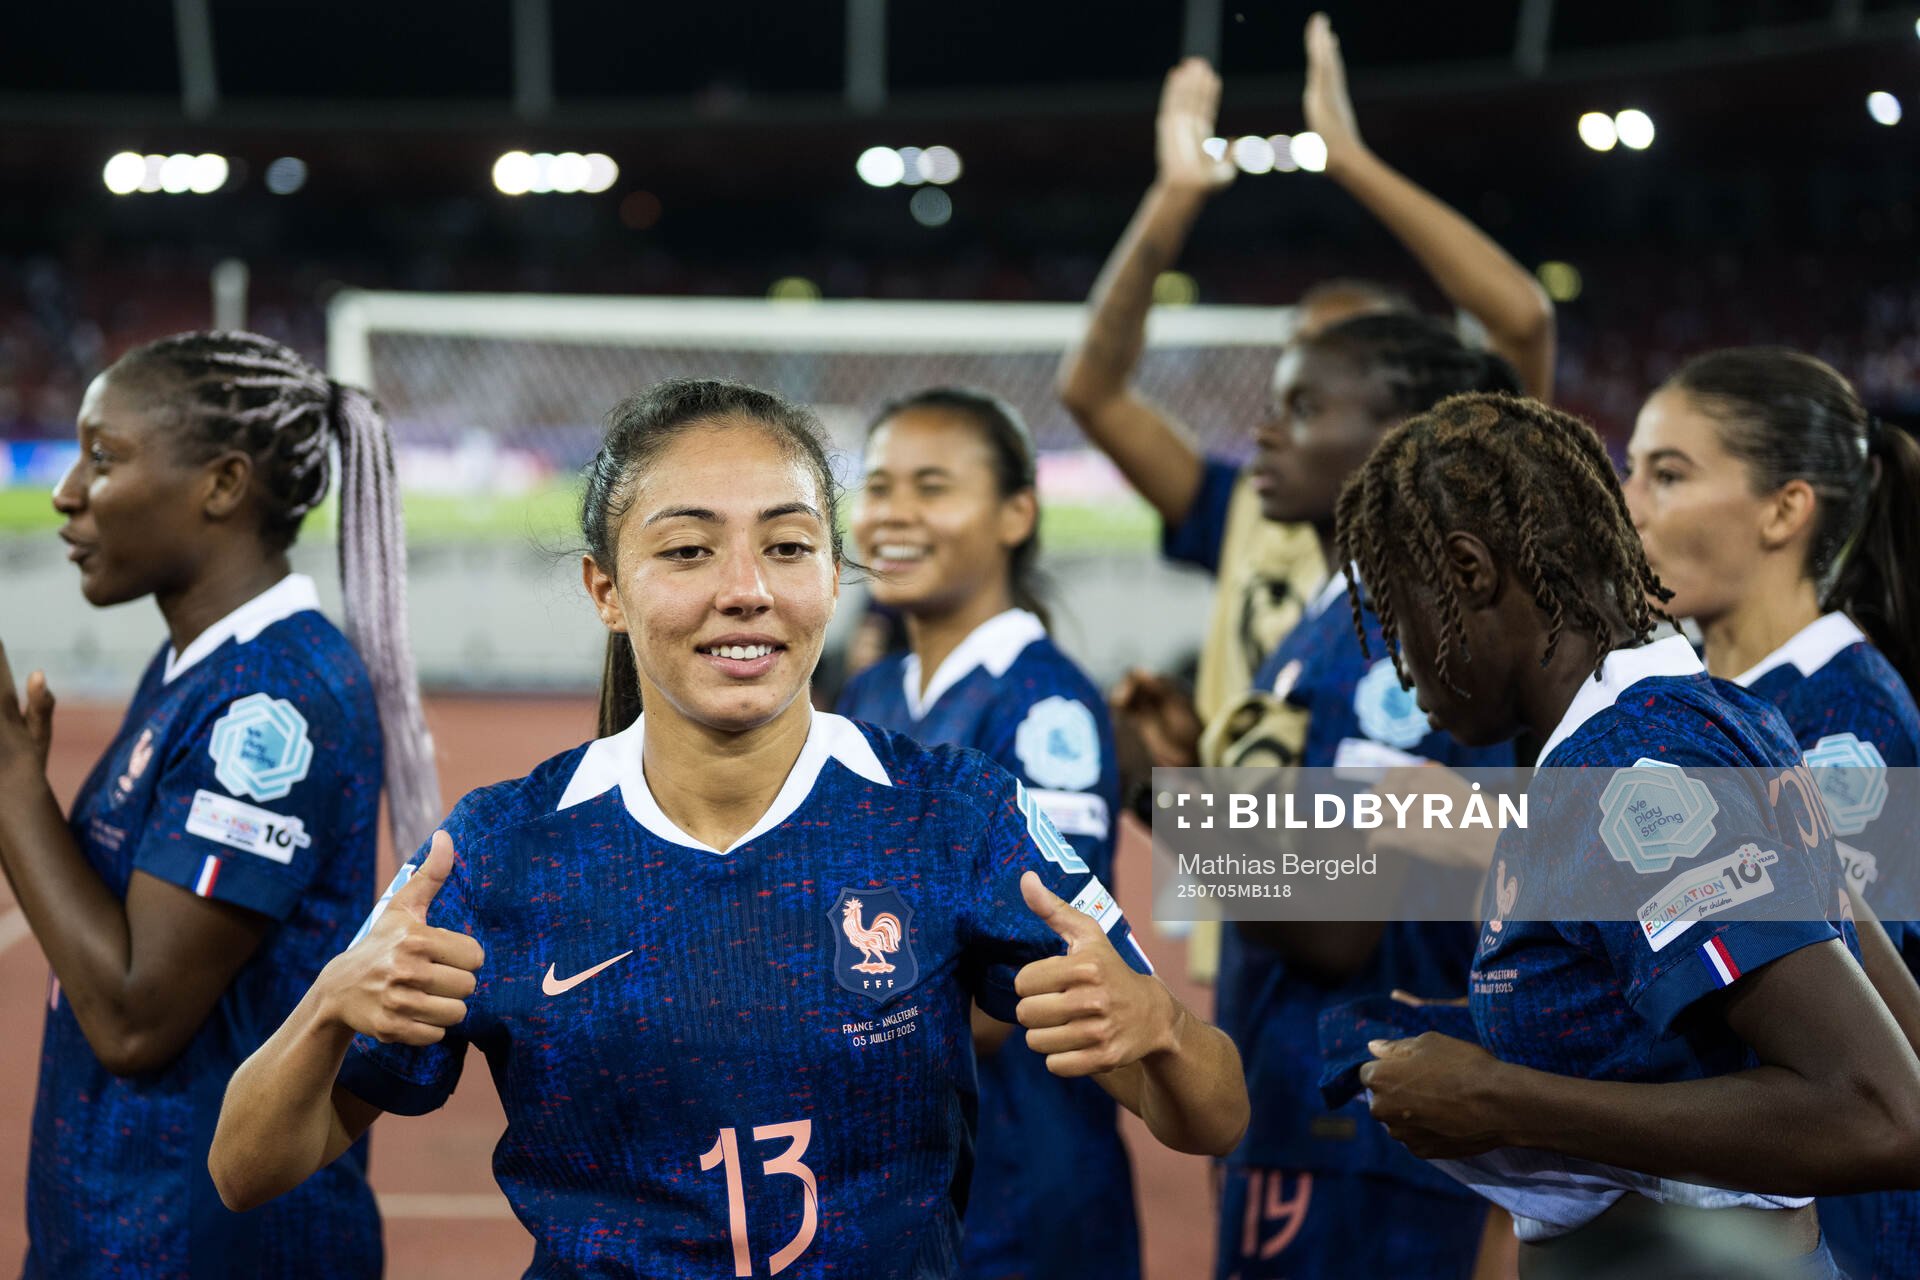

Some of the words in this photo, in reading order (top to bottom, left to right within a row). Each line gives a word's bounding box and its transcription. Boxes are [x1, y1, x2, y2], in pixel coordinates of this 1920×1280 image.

[1628, 800, 1647, 814] We
[265, 824, 292, 848] 10
[1722, 861, 1763, 890] 10
[842, 1021, 874, 1035] FRANCE
[882, 1006, 919, 1028] ANGLETERRE
[853, 1036, 867, 1047] 05
[870, 1029, 895, 1045] JUILLET
[897, 1022, 916, 1037] 2025
[699, 1119, 818, 1277] 13
